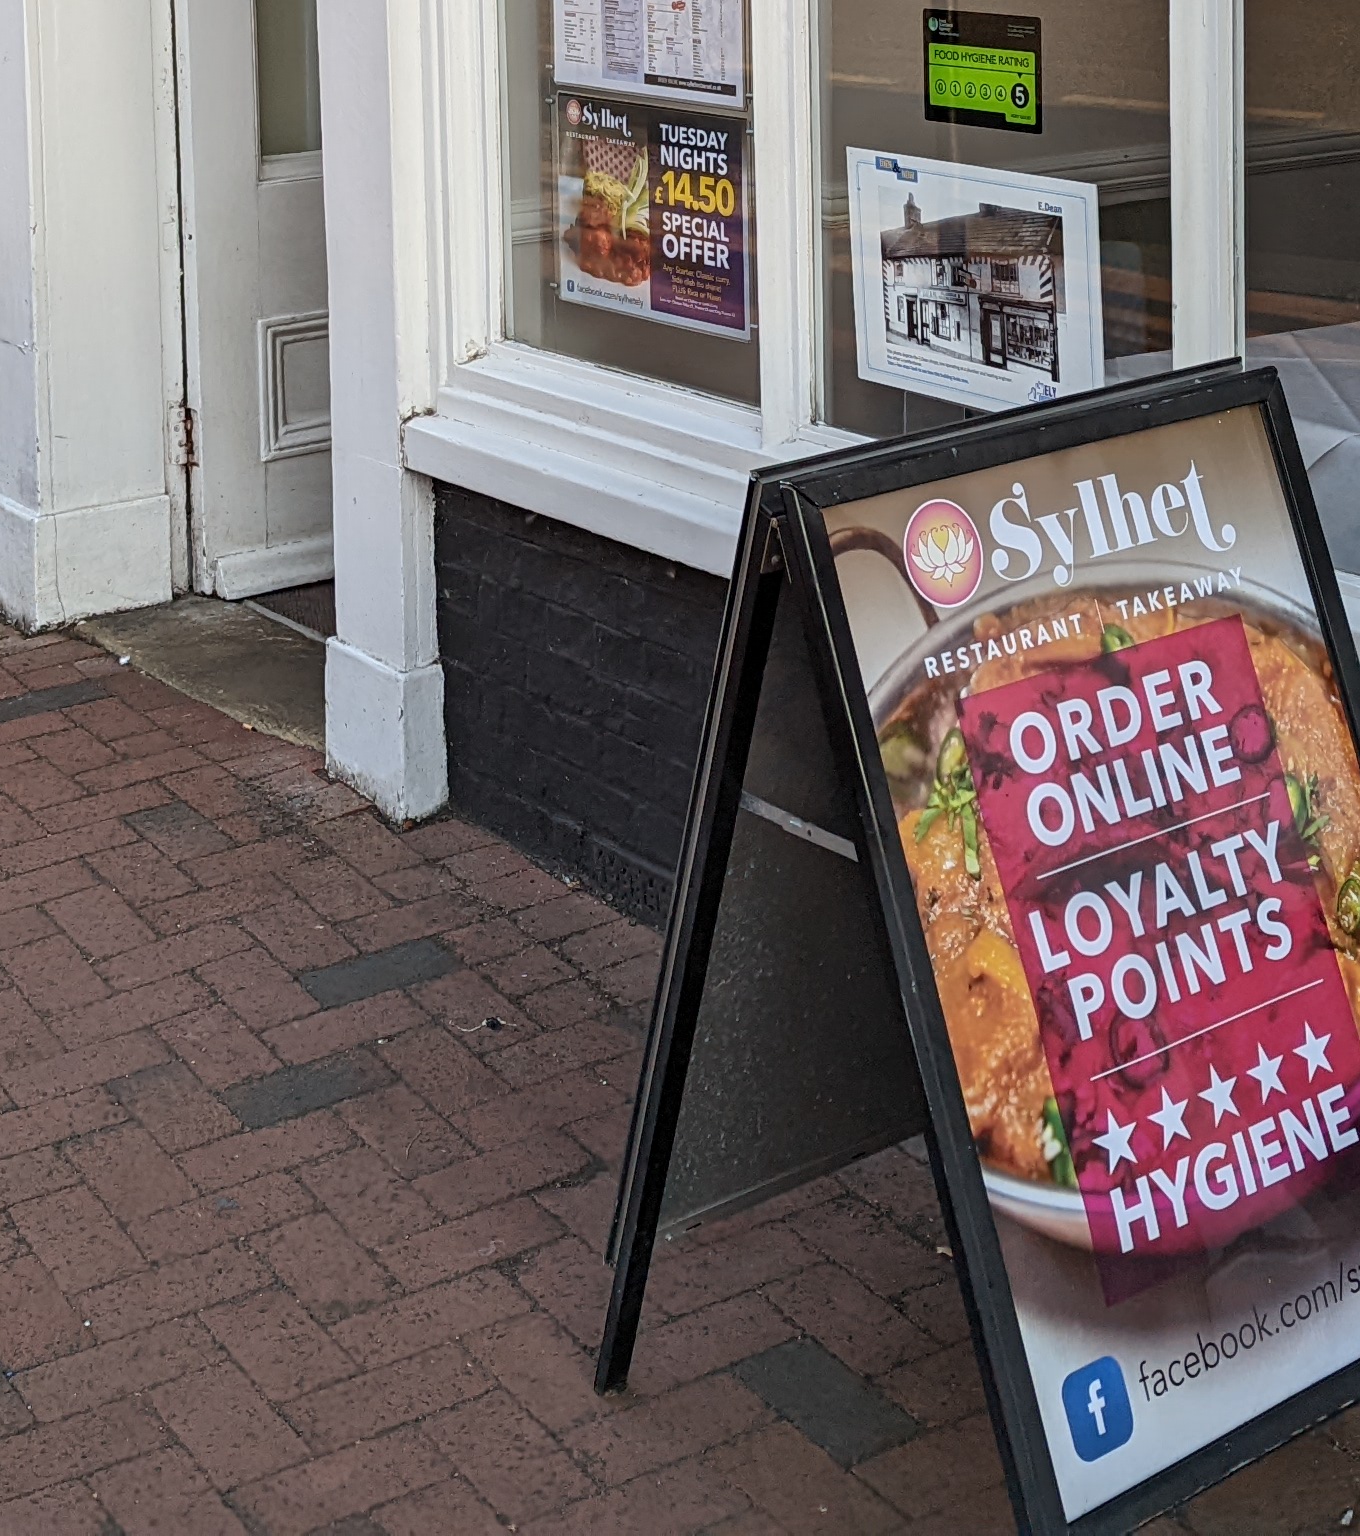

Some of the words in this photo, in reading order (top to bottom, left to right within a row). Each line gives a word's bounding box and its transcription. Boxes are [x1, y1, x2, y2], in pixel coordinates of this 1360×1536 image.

[934, 50, 959, 61] FOOD
[960, 52, 997, 64] HYGIENE
[998, 56, 1030, 68] RATING
[582, 102, 632, 137] Sylhet
[1015, 86, 1025, 106] 5
[659, 123, 728, 151] TUESDAY
[660, 145, 728, 176] NIGHTS
[654, 170, 735, 217] £14.50
[662, 211, 730, 243] SPECIAL
[662, 236, 730, 270] OFFER
[988, 459, 1236, 587] Sylhet
[924, 612, 1084, 679] RESTAURANT
[1116, 566, 1244, 620] TAKEAWAY
[1008, 660, 1222, 774] ORDER
[1026, 723, 1241, 847] ONLINE
[1027, 820, 1280, 974] LOYALTY
[1067, 899, 1293, 1042] POINTS
[1109, 1083, 1359, 1254] HYGIENE
